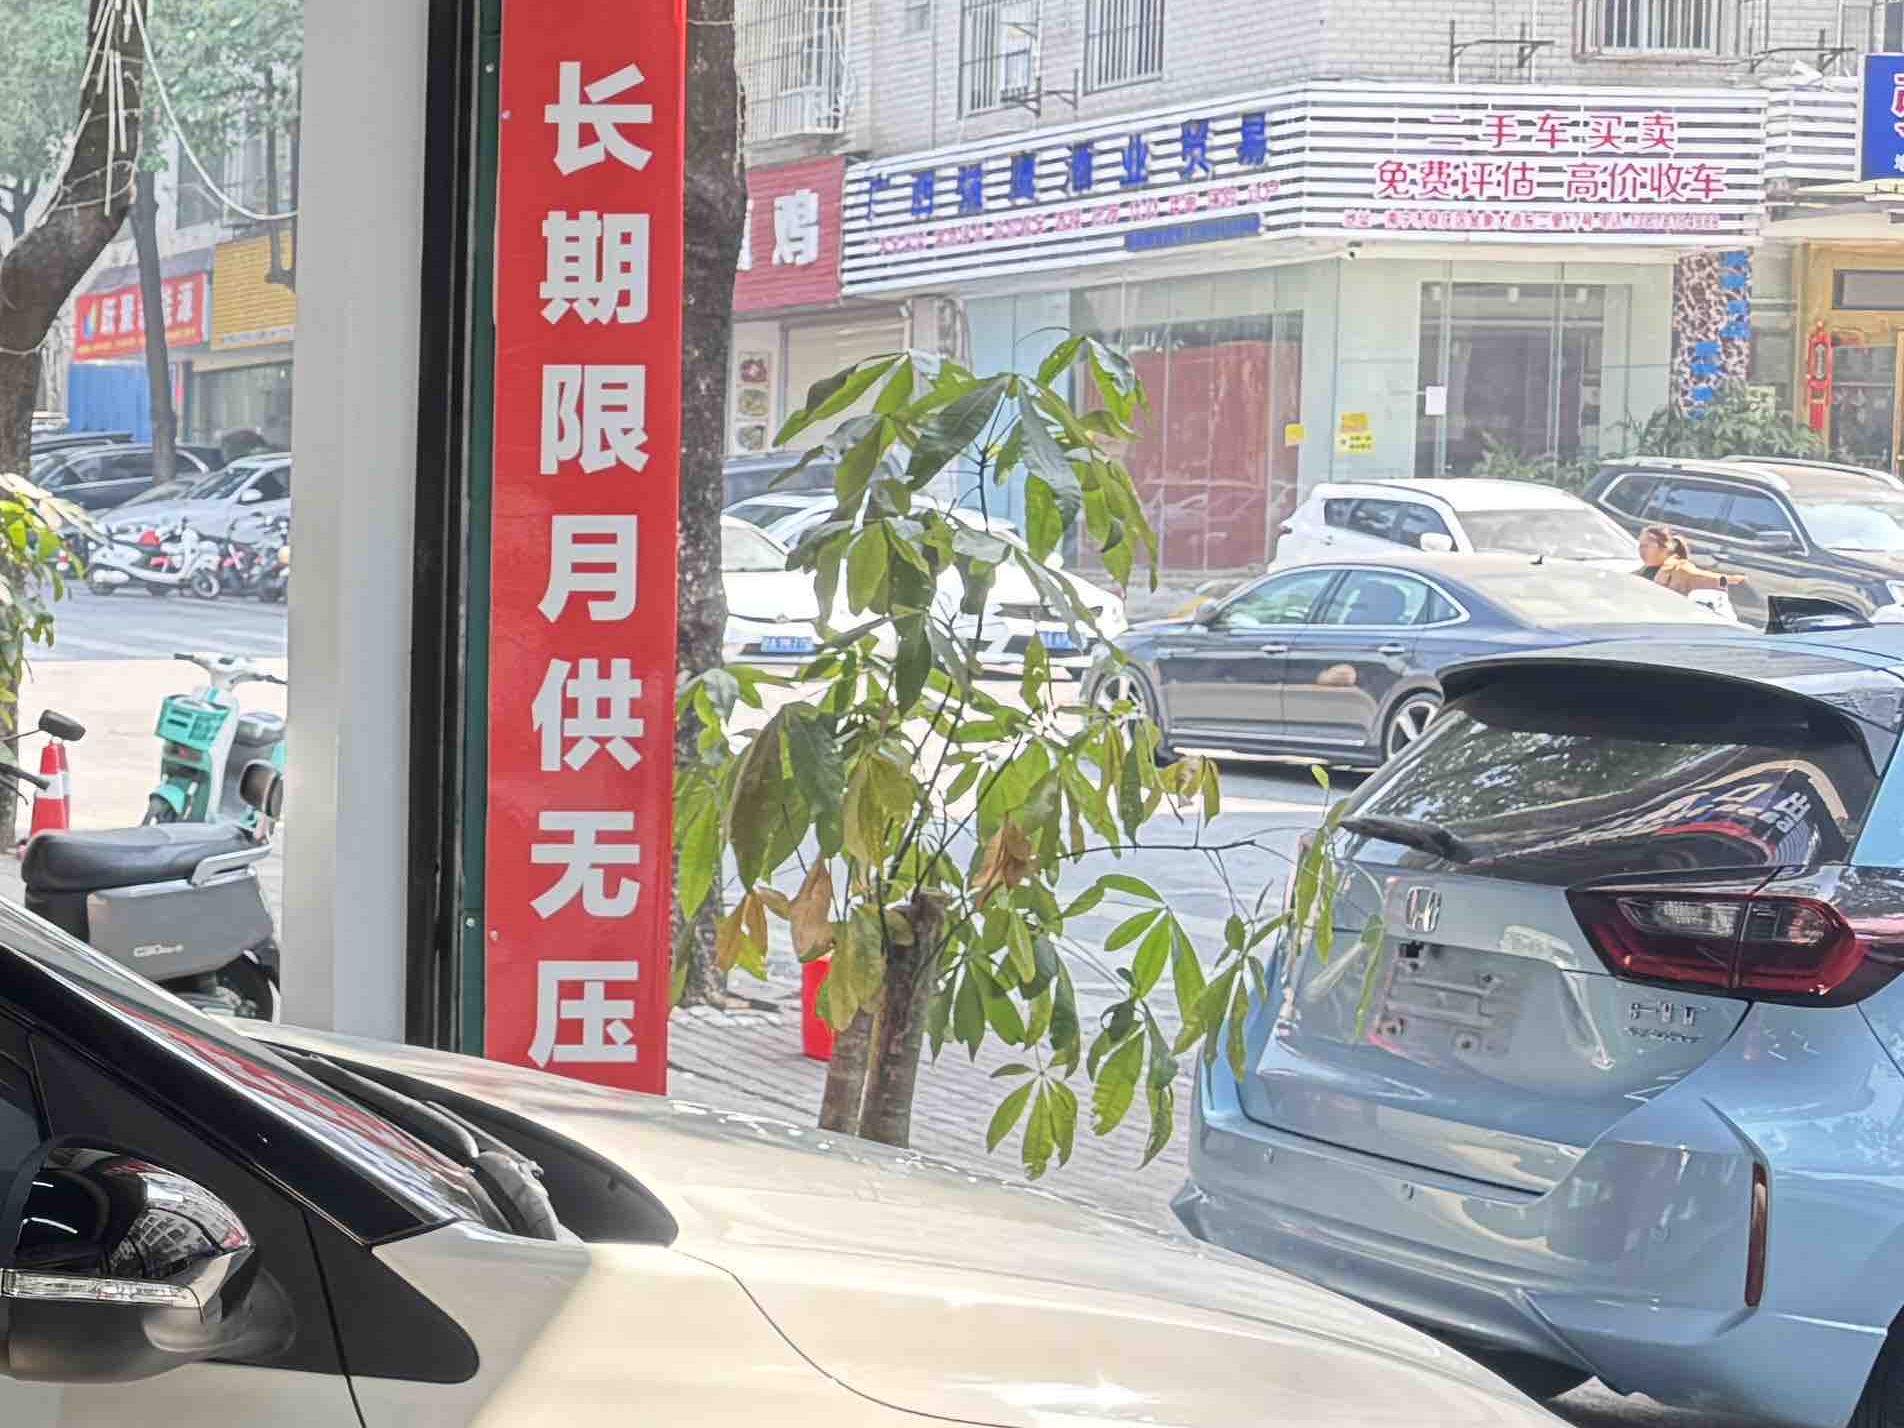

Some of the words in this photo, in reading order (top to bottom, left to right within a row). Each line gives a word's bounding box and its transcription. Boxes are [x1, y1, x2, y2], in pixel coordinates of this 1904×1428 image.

[1428, 113, 1678, 151] 二手车买卖
[1376, 159, 1536, 200] 免费评估
[1565, 162, 1727, 201] 高价收车
[527, 62, 652, 1069] 长期限月供无压
